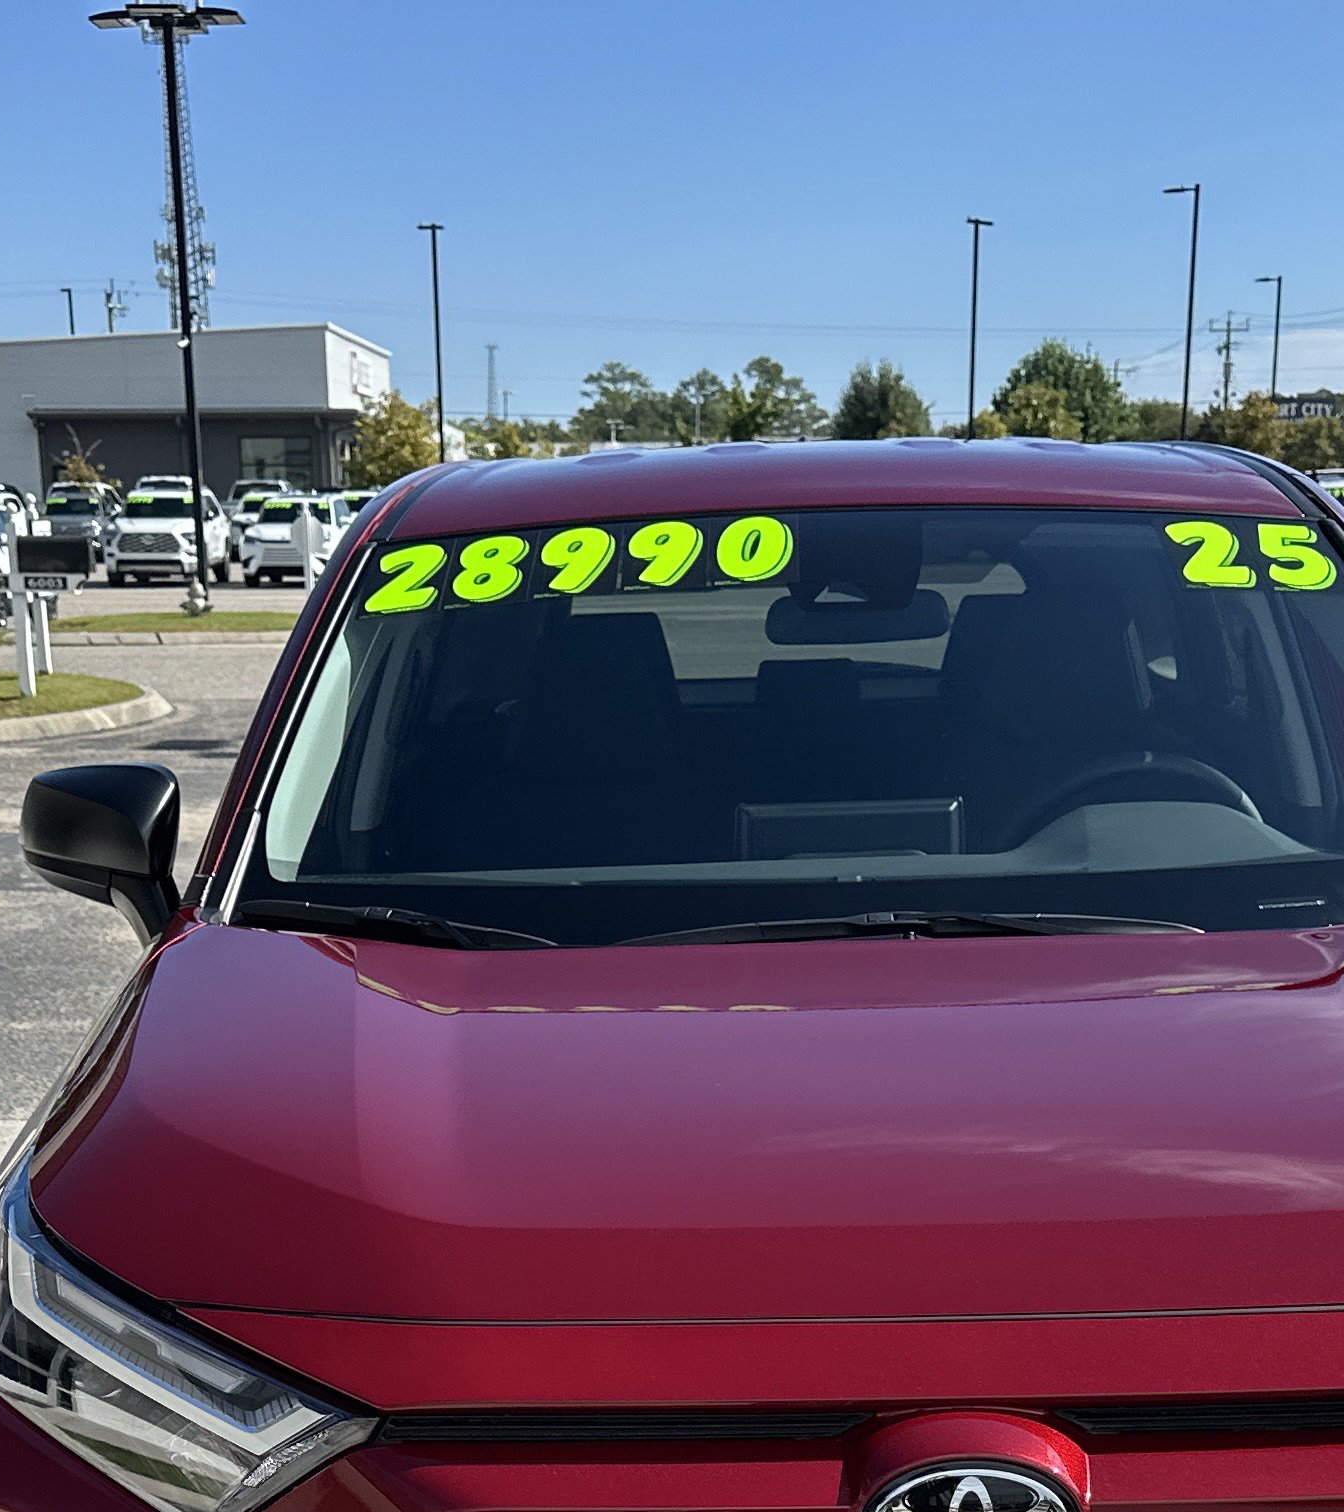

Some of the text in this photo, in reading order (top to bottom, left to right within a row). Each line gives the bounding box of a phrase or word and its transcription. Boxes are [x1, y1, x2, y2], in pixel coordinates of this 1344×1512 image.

[1302, 402, 1334, 417] CITY
[364, 516, 794, 613] 28990
[1164, 521, 1337, 590] 25
